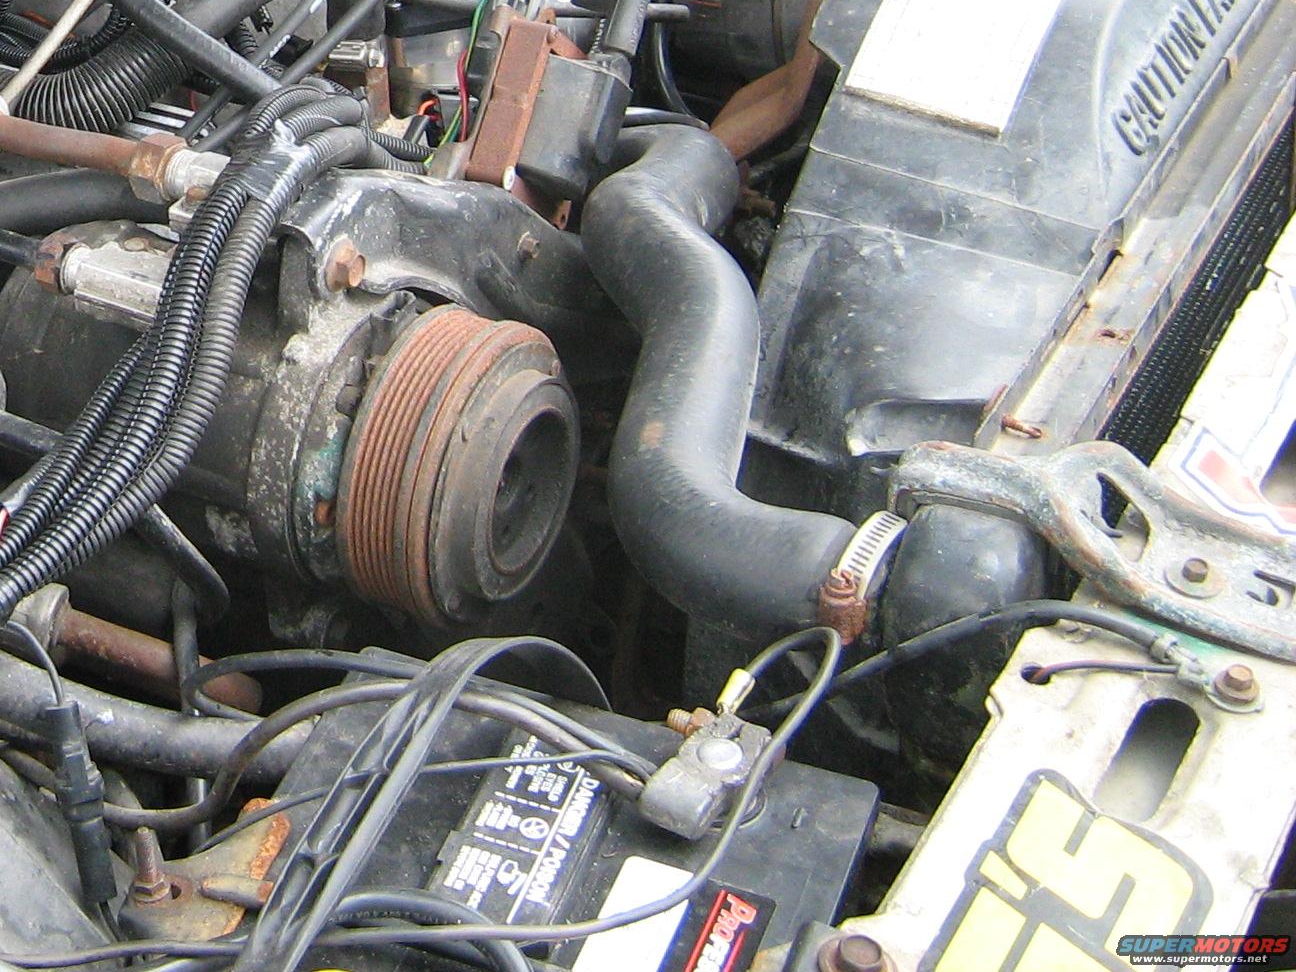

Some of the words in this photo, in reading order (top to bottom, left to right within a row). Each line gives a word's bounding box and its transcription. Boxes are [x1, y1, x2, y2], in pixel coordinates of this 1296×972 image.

[1111, 10, 1207, 157] CAUTION
[555, 776, 600, 837] DANGER
[526, 846, 567, 905] POISON
